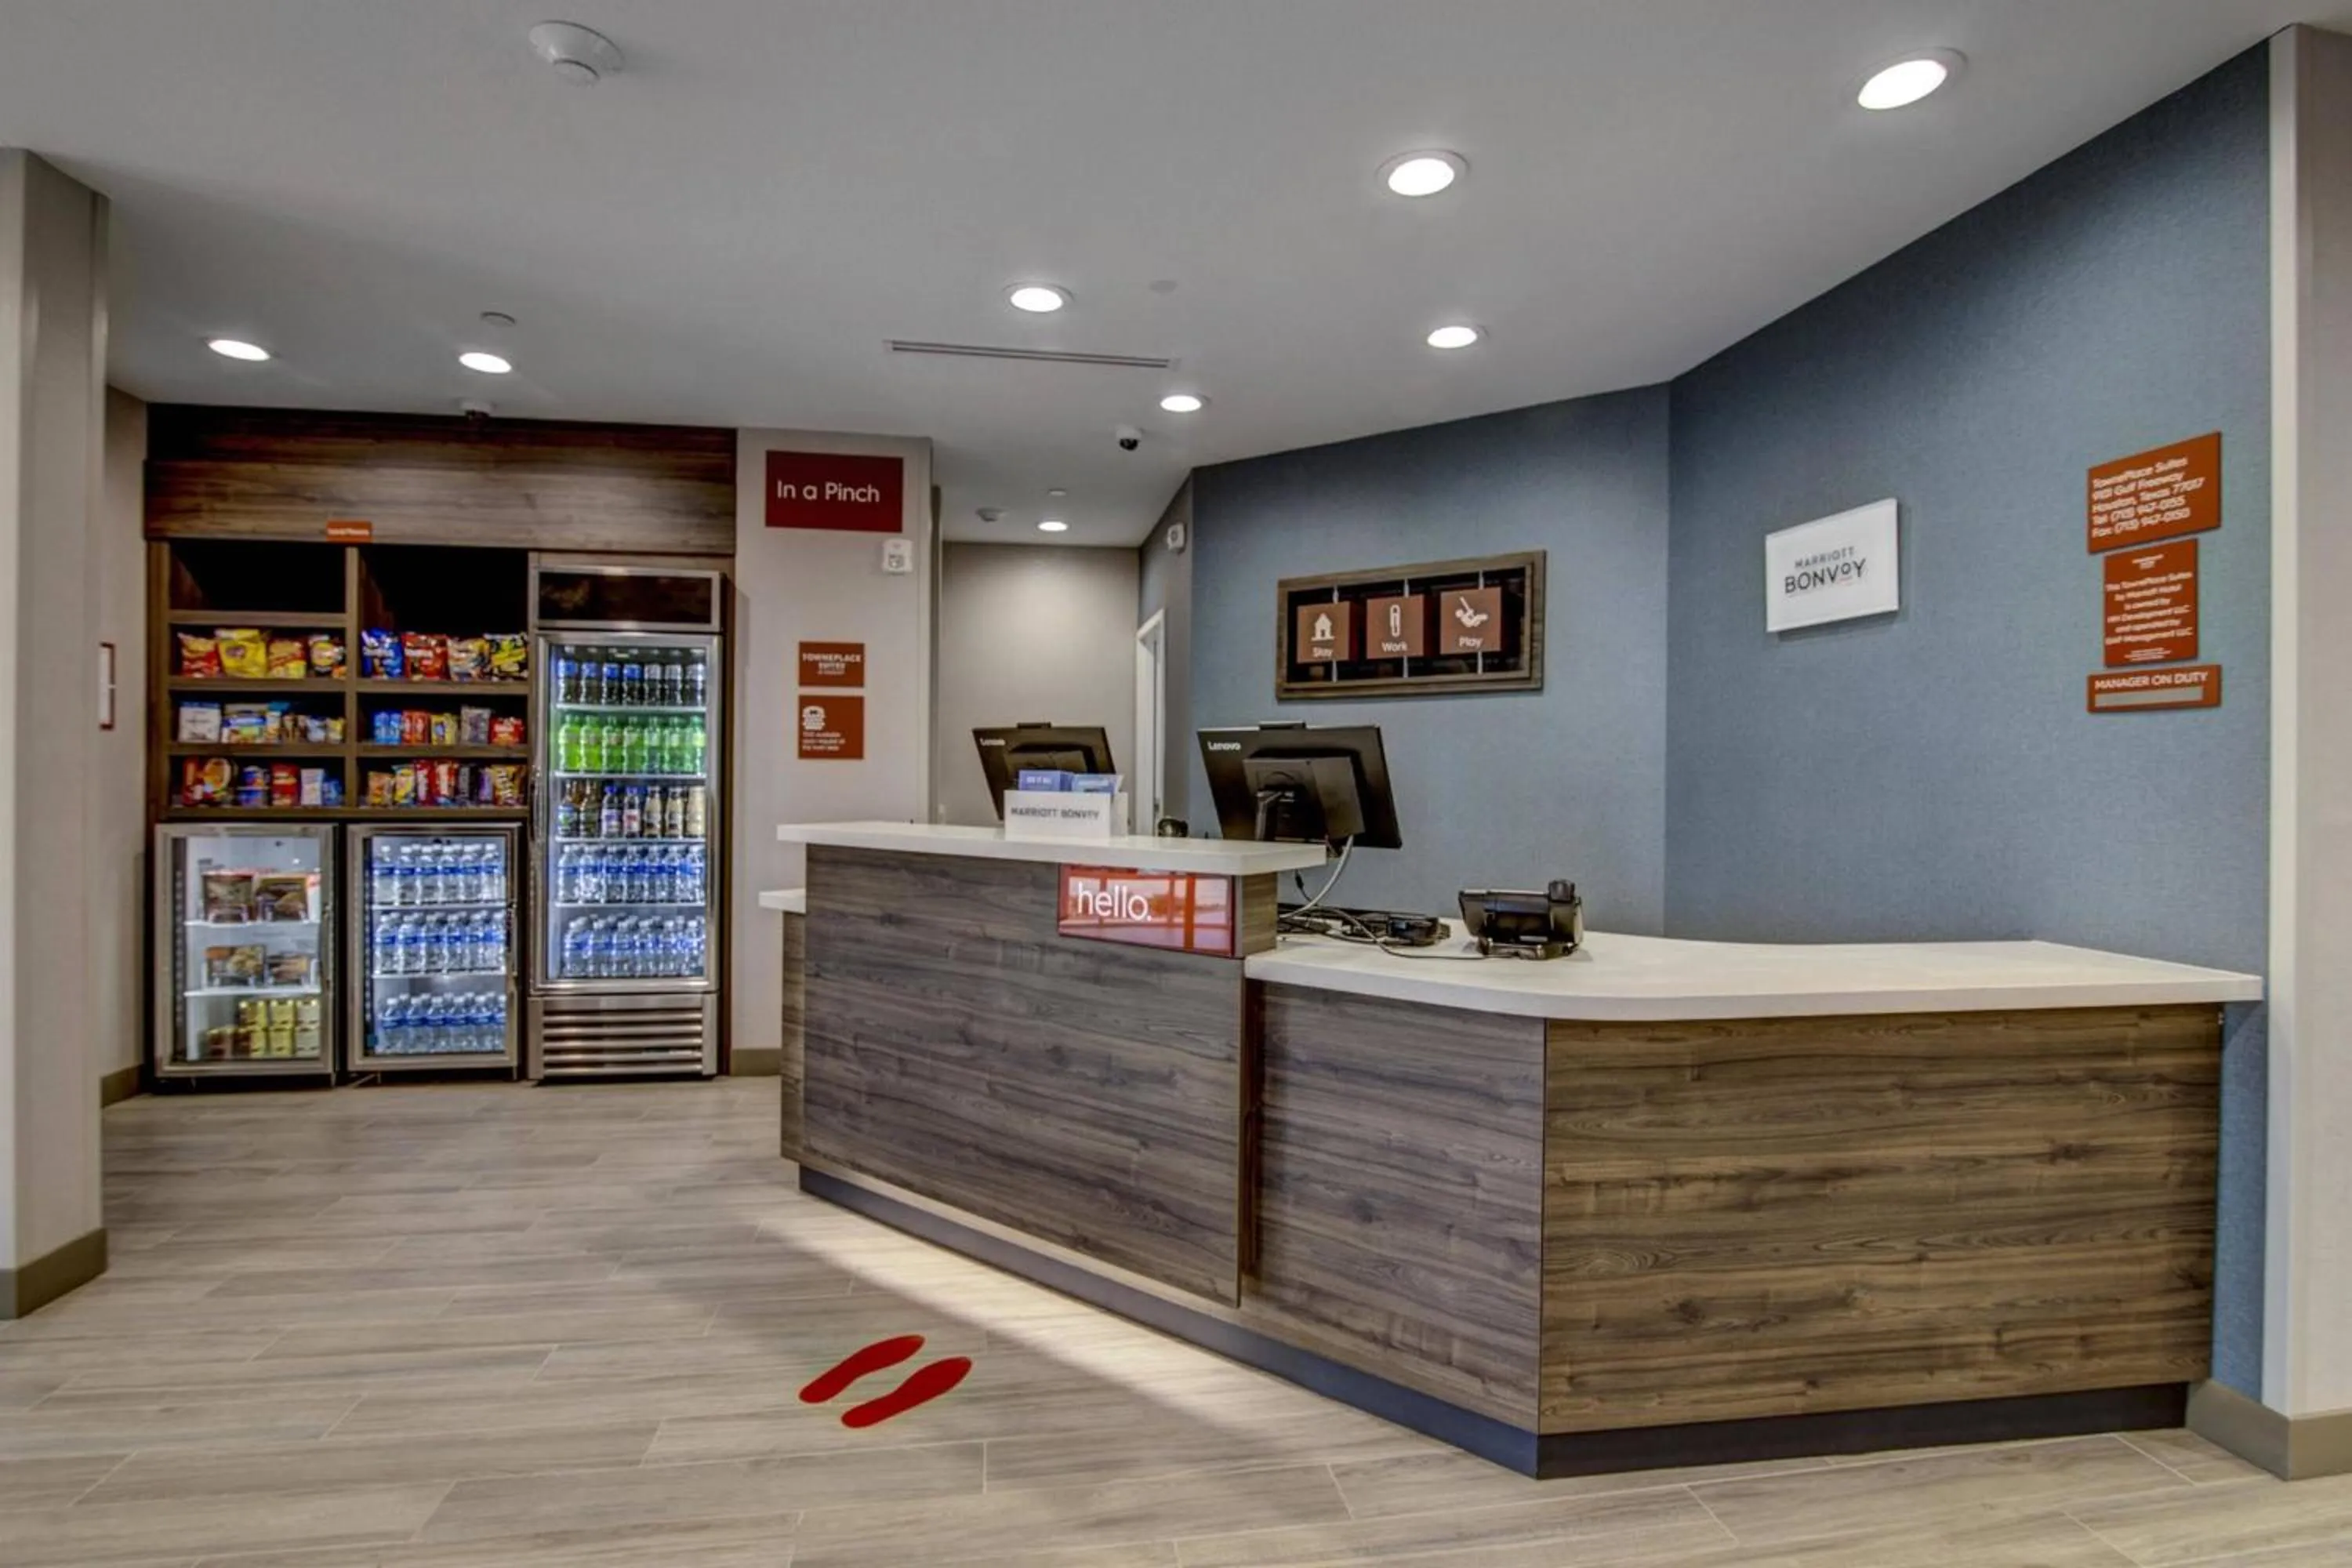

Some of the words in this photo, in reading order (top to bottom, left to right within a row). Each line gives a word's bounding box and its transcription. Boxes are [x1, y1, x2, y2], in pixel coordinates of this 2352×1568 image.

[777, 479, 796, 499] In
[802, 485, 818, 500] a
[825, 481, 880, 503] Pinch
[1795, 546, 1855, 568] MARRIOTT
[1784, 557, 1866, 594] BONVOY
[1381, 641, 1408, 652] Work
[1459, 636, 1483, 649] Play
[2095, 676, 2150, 690] MANAGER
[2151, 674, 2172, 686] ON
[2174, 671, 2209, 684] DUTY
[1207, 741, 1242, 751] Lenovo
[1011, 807, 1057, 818] MARRIOTT
[1078, 880, 1152, 922] hello.
